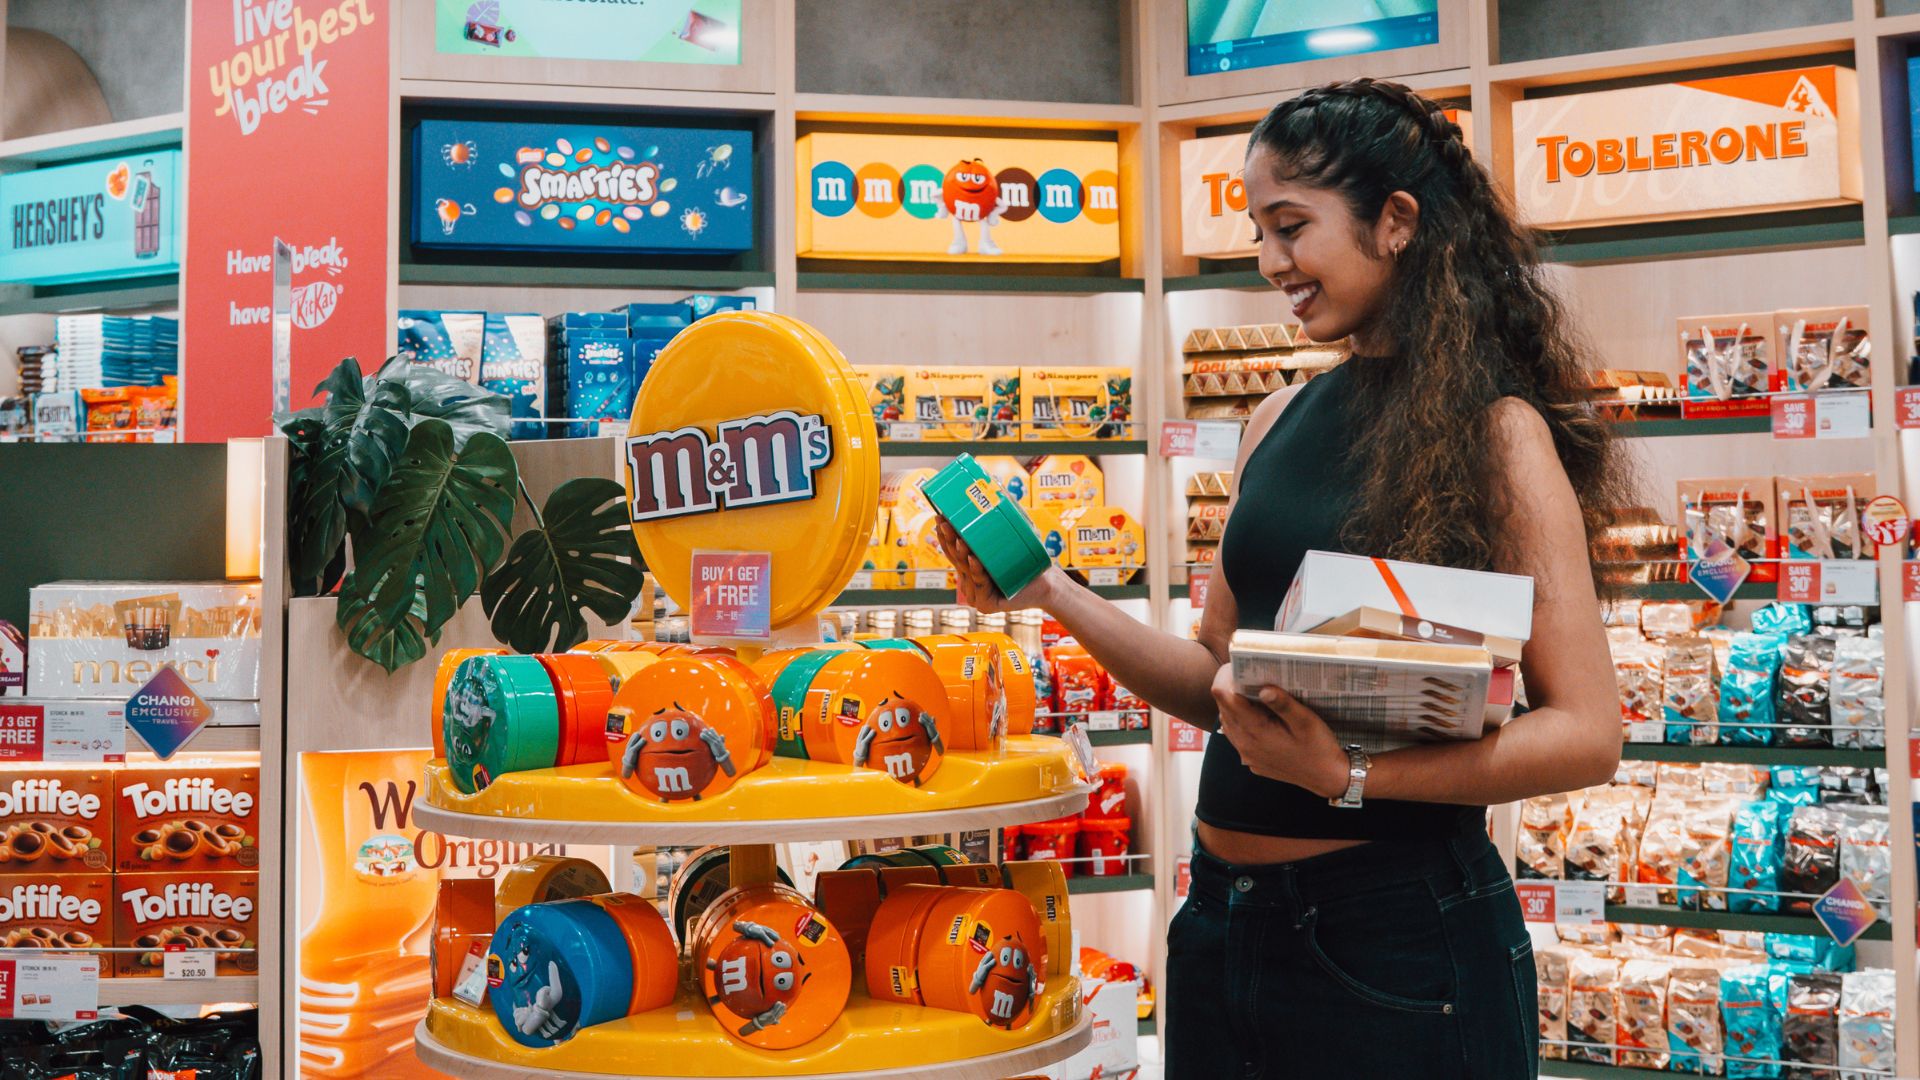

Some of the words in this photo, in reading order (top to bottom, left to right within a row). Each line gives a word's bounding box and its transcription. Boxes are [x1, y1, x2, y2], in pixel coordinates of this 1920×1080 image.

[233, 0, 293, 46] live
[209, 29, 290, 117] your
[293, 0, 375, 56] best
[233, 48, 329, 136] break
[1536, 120, 1808, 184] TOBLERONE
[12, 193, 104, 249] HERSHEY'S
[226, 249, 271, 275] Have
[229, 301, 271, 326] have
[1783, 403, 1806, 412] SAVE
[702, 566, 725, 581] BUY
[727, 566, 734, 581] 1
[737, 566, 760, 581] GET
[1788, 566, 1811, 576] SAVE
[703, 585, 711, 606] 1
[718, 585, 759, 606] FREE
[131, 707, 200, 717] EXCLUSIVE
[137, 694, 195, 706] CHANGI
[7, 716, 14, 727] 3
[17, 716, 38, 727] GET
[883, 752, 915, 778] m
[654, 766, 693, 792] m
[122, 778, 254, 819] Toffifee
[122, 883, 253, 923] Toffifee
[181, 968, 207, 977] $20.50
[990, 989, 1015, 1018] m
